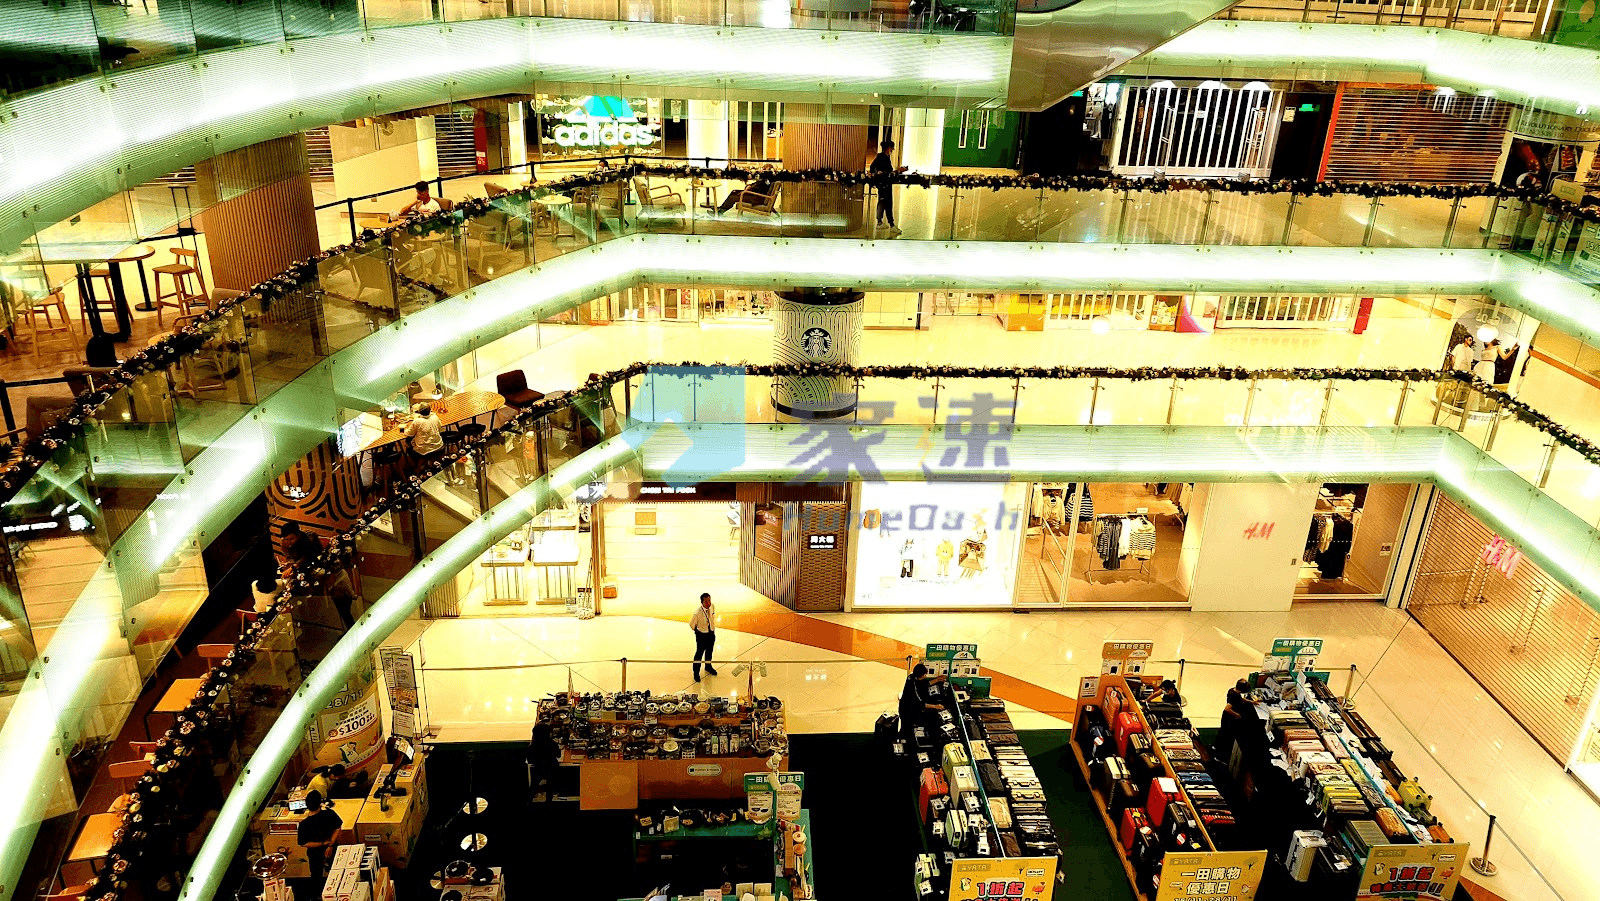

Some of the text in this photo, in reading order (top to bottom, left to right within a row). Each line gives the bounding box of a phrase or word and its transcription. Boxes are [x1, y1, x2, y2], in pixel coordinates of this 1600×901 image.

[555, 119, 654, 146] adidas
[1242, 522, 1275, 540] H&M
[1480, 534, 1523, 580] H&M
[339, 717, 366, 735] $100
[1181, 867, 1241, 880] 一田購物
[1186, 881, 1230, 895] 優惠日
